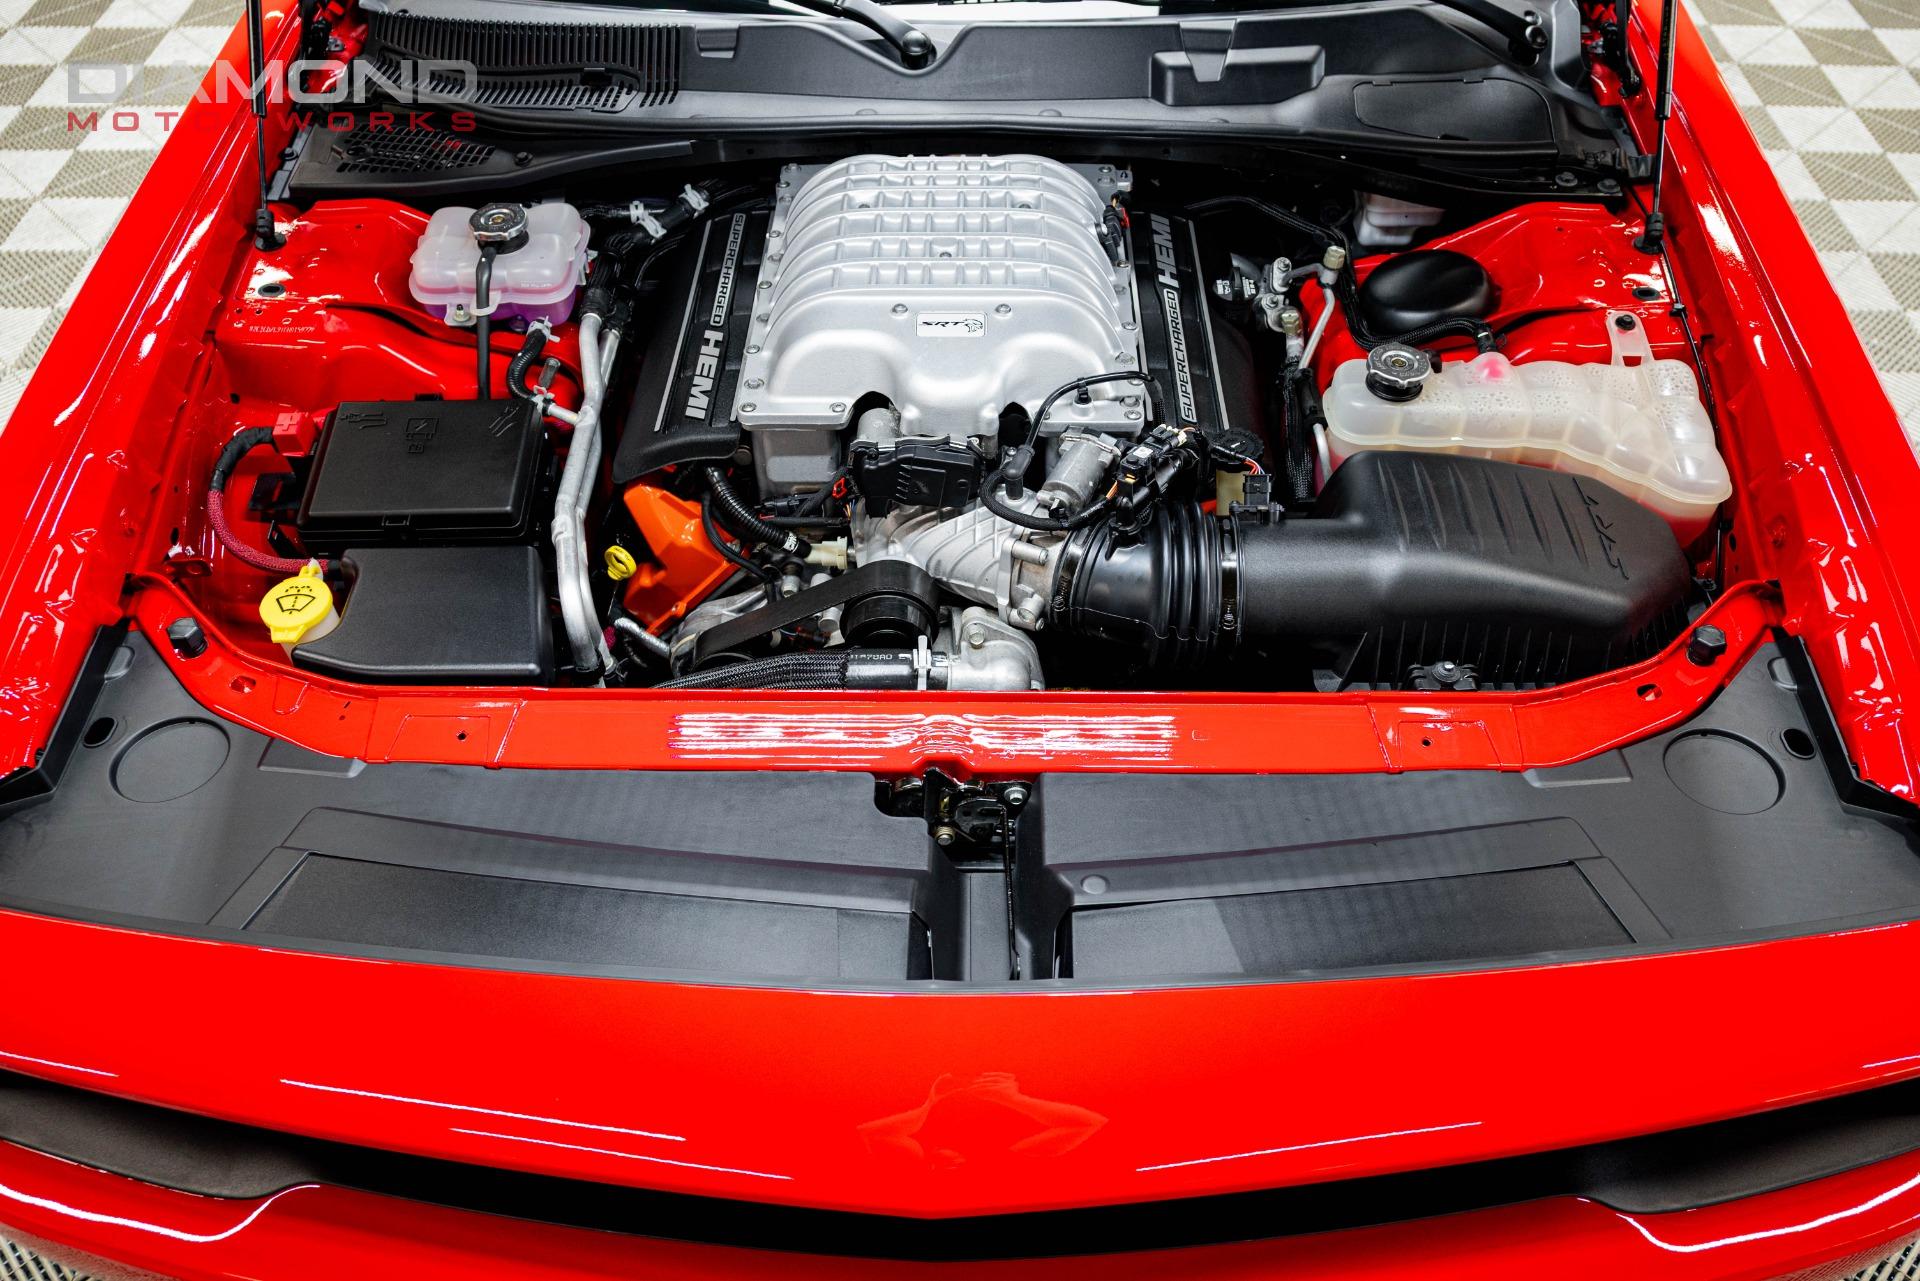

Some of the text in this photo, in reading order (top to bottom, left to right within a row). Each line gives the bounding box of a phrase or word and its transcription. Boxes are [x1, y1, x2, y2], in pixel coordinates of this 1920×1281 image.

[685, 213, 745, 420] SUPERCHARGED HEMI
[1151, 213, 1196, 421] SUPERCHARGED HEMI
